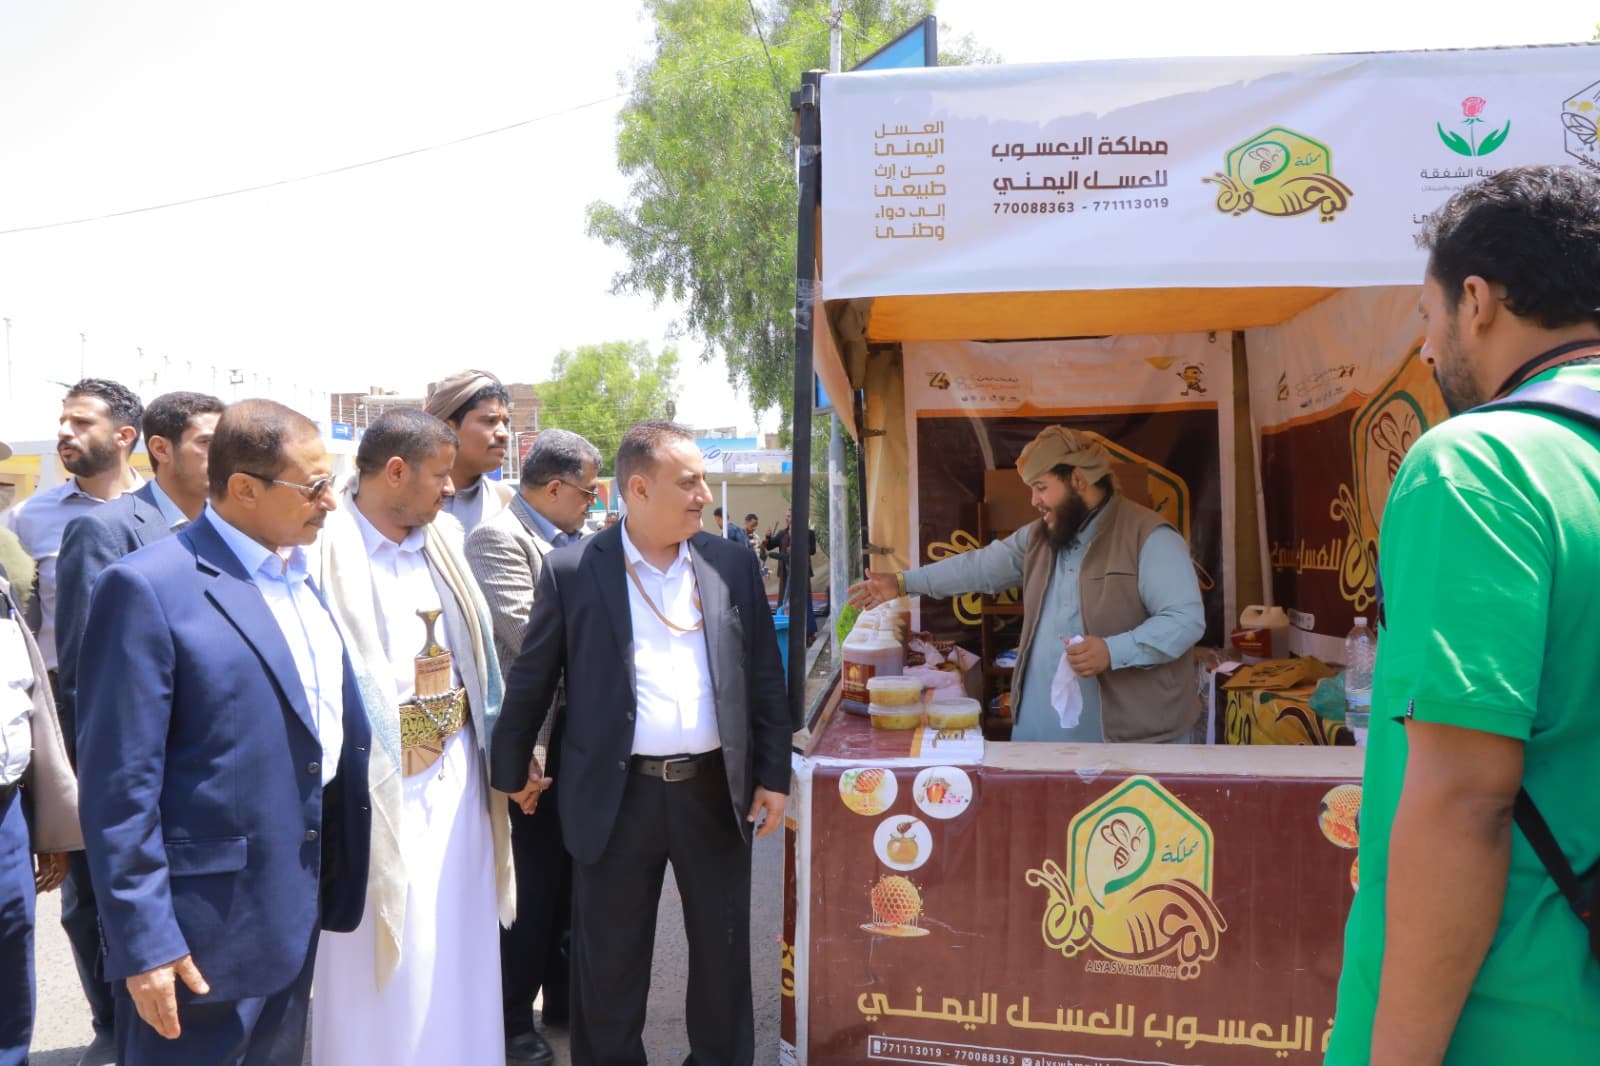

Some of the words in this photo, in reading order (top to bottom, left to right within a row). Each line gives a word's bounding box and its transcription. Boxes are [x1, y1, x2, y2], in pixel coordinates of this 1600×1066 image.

[874, 120, 944, 139] العسل
[991, 137, 1093, 162] اليعسوب
[1098, 136, 1169, 156] مملكة
[900, 164, 945, 179] من
[1083, 170, 1168, 189] للعسل
[1420, 167, 1473, 179] الشفقة
[993, 171, 1079, 195] اليمني
[875, 204, 906, 220] دواء
[993, 202, 1075, 214] 770088363
[1093, 197, 1169, 212] 771113019
[1085, 959, 1178, 979] ALYASWBMMLKH
[857, 986, 998, 1031] اليمني
[1006, 996, 1135, 1036] للعسل
[1144, 1015, 1313, 1058] اليعسوب
[881, 1041, 942, 1057] 771113019
[954, 1049, 1016, 1065] 770088363
